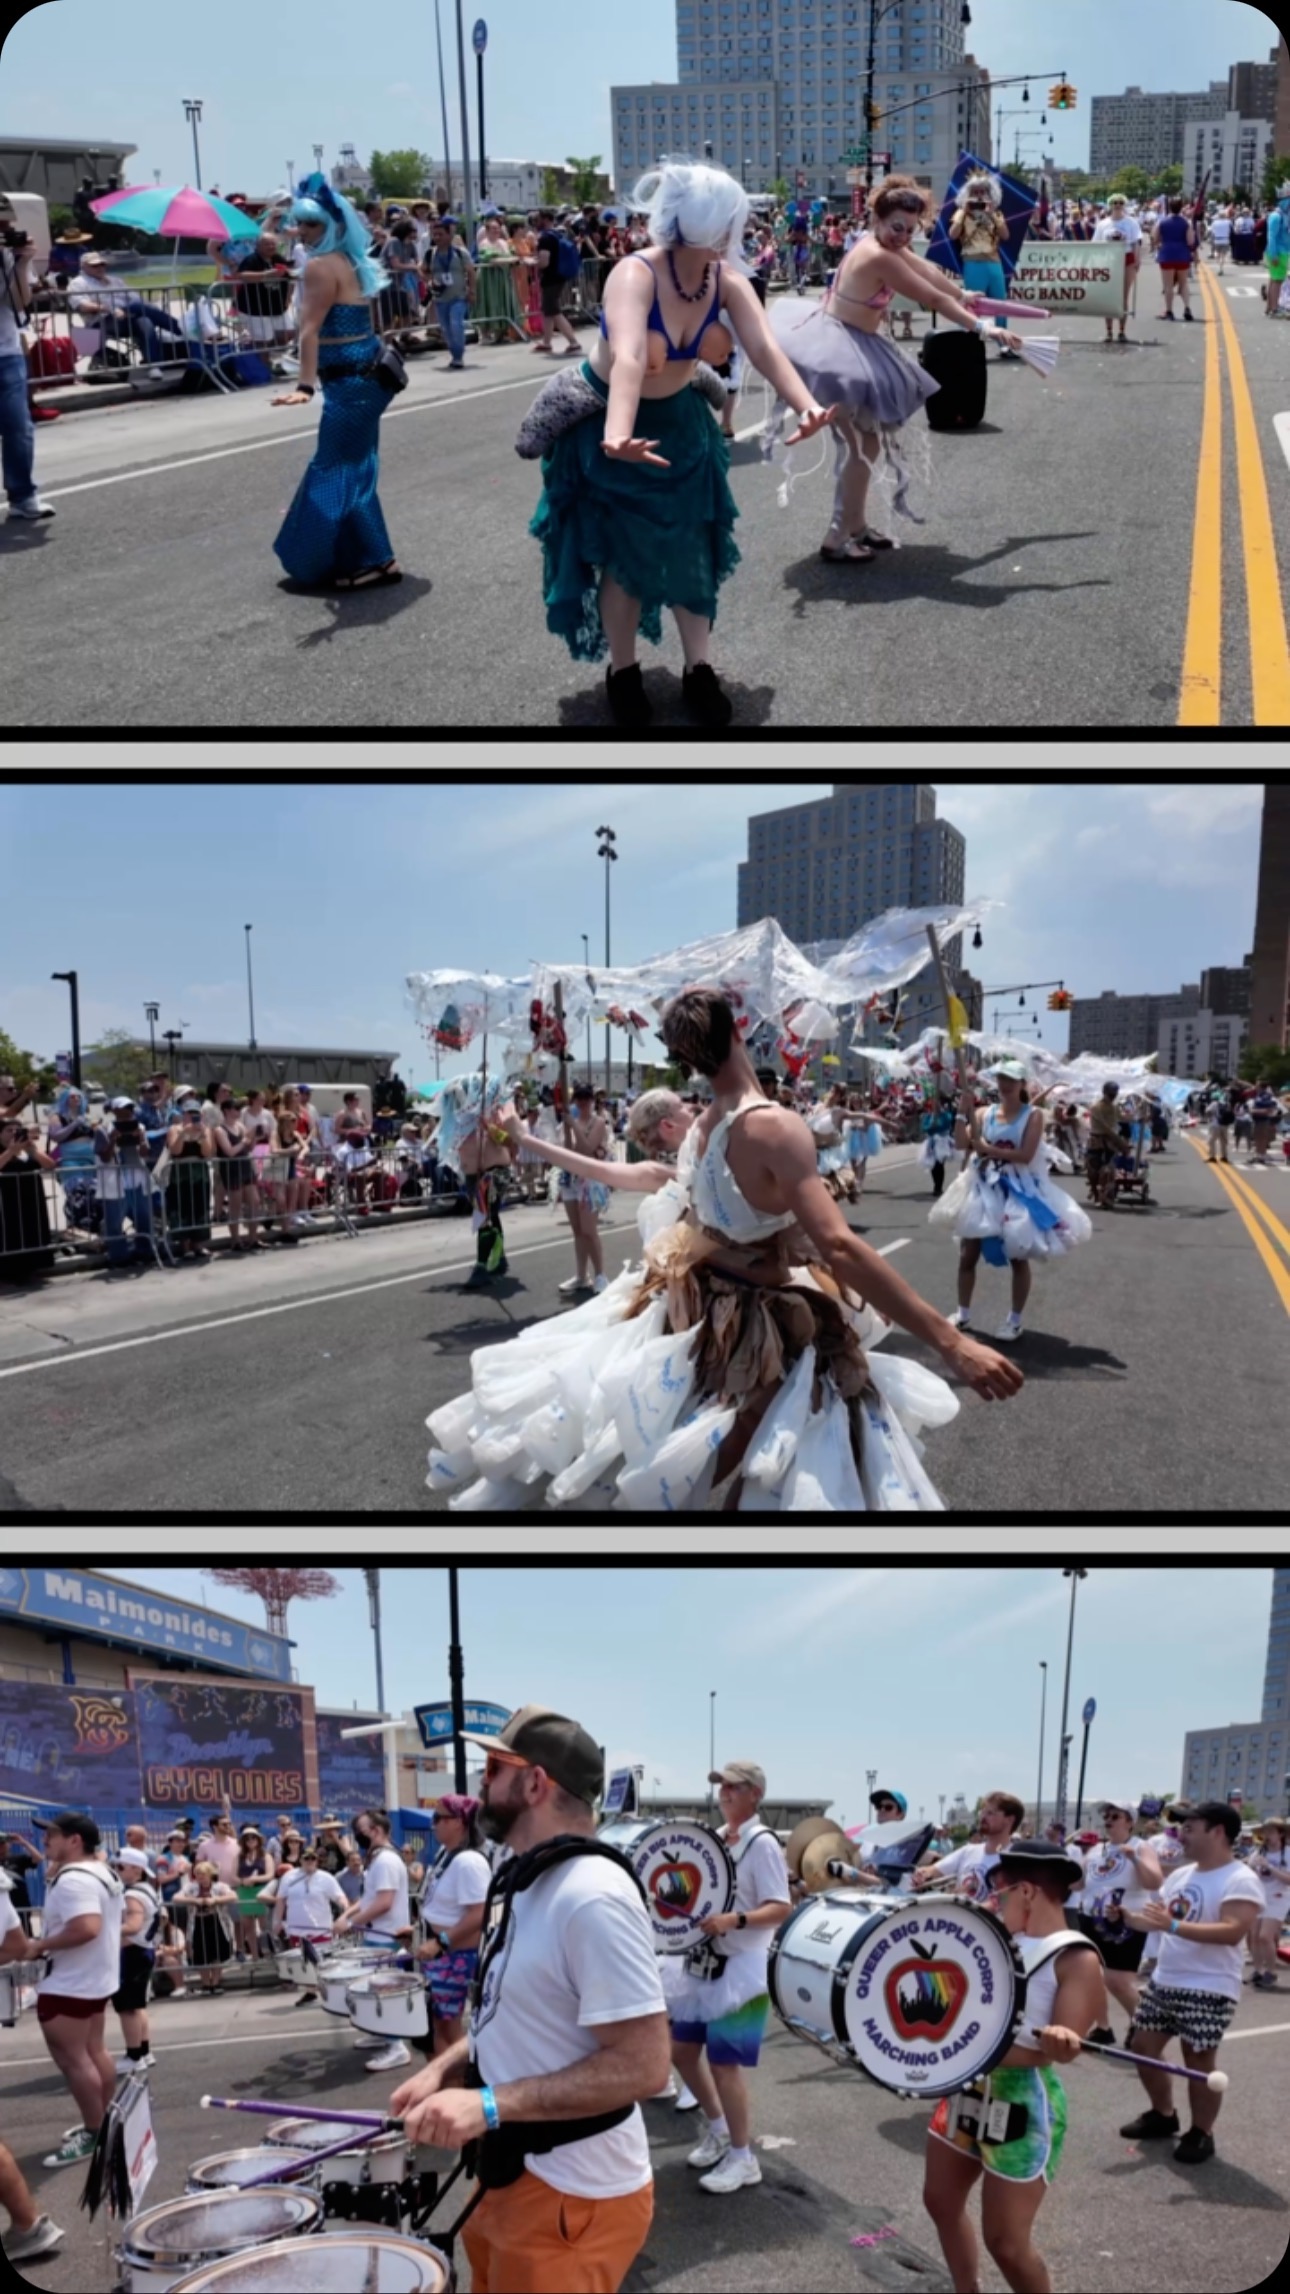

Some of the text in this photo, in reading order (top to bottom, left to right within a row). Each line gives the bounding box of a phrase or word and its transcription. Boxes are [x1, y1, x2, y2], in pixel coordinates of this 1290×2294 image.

[1038, 287, 1086, 300] BAND
[44, 1572, 233, 1648] Maimonides
[148, 1768, 303, 1803] CYCLONES
[648, 1837, 667, 1855] BIG
[670, 1834, 703, 1852] APPLE
[701, 1849, 719, 1889] CORPS
[856, 1918, 995, 2005] QUEER BIG APPLE CORPS
[862, 2017, 982, 2066] MARCHING BAND
